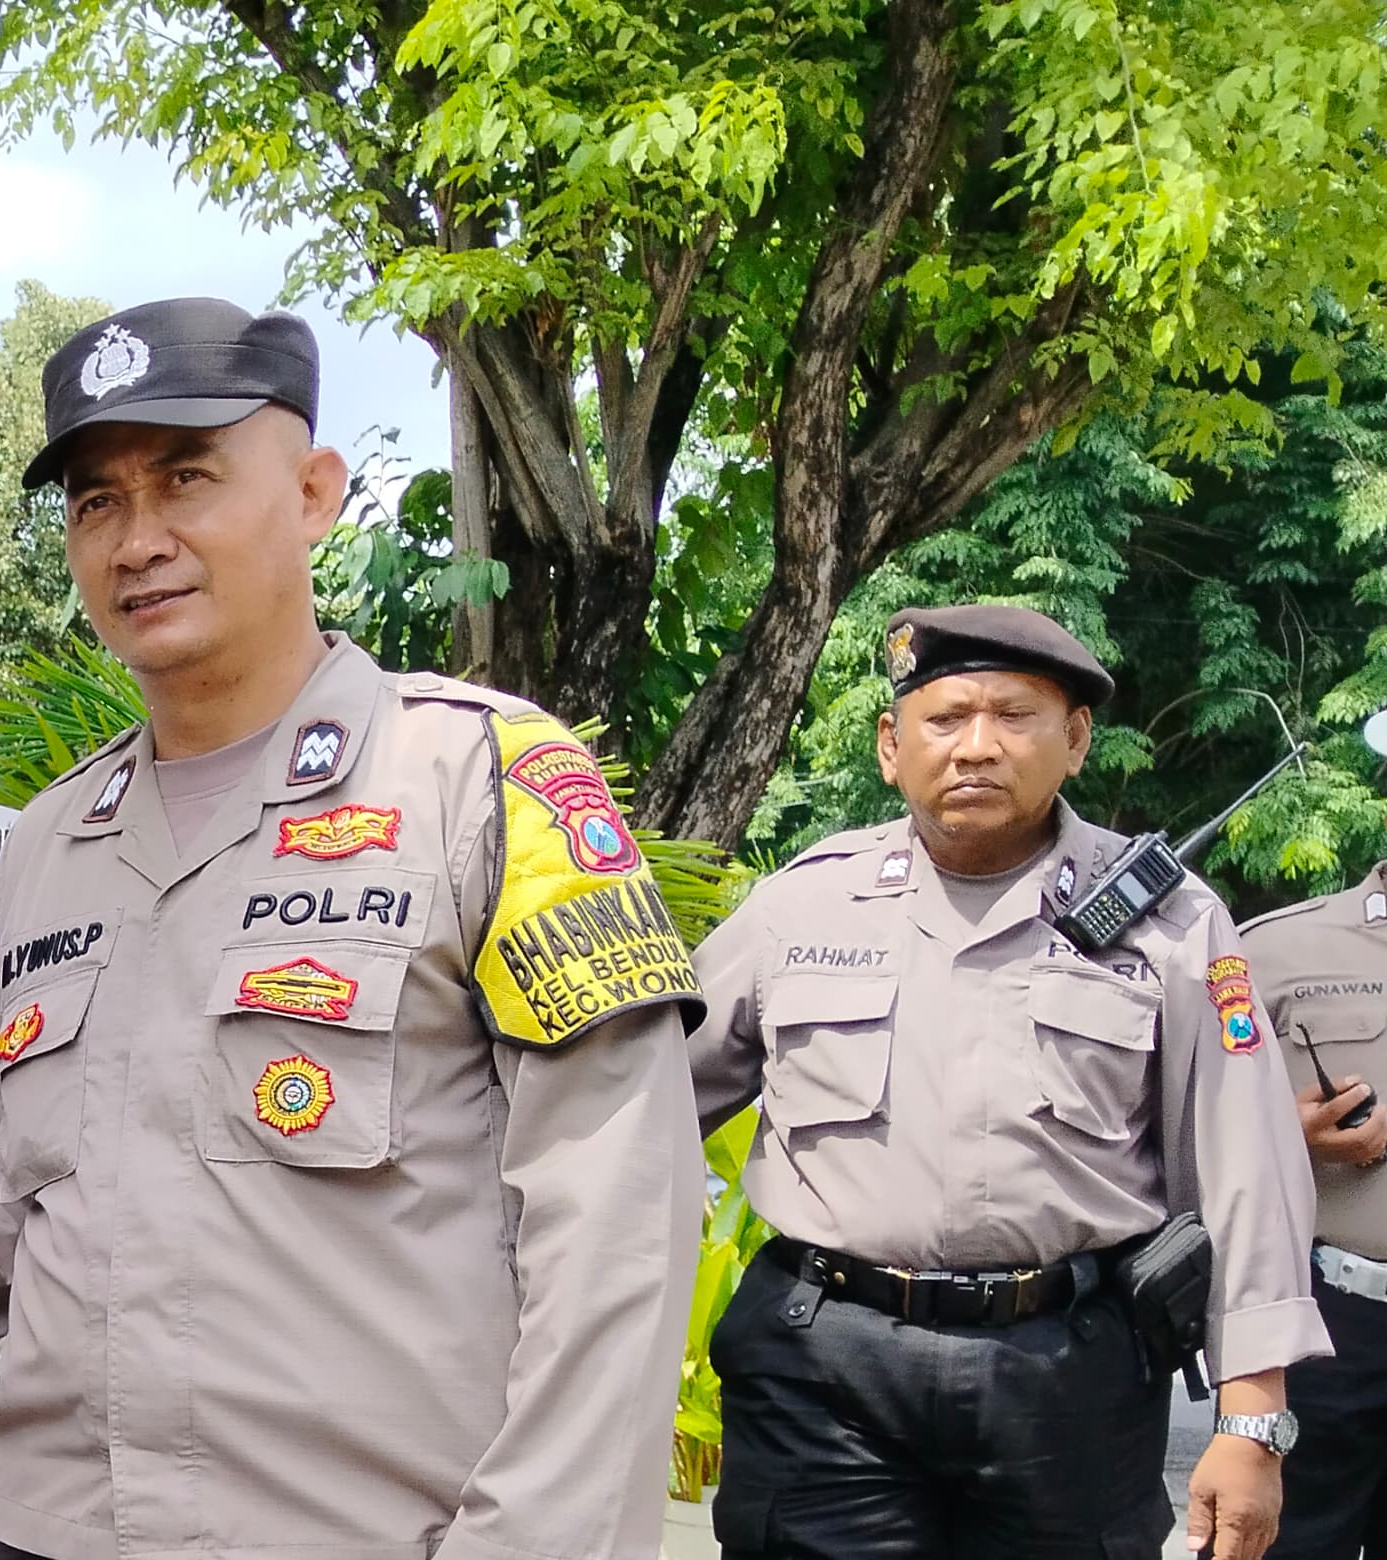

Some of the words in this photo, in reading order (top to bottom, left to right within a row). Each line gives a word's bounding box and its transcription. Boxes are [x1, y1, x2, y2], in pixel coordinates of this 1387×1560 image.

[242, 887, 412, 930] POLRI
[785, 946, 890, 968] RAHMAT
[538, 966, 704, 1040] KEC.WONO
[1294, 982, 1383, 999] GUNAWAN
